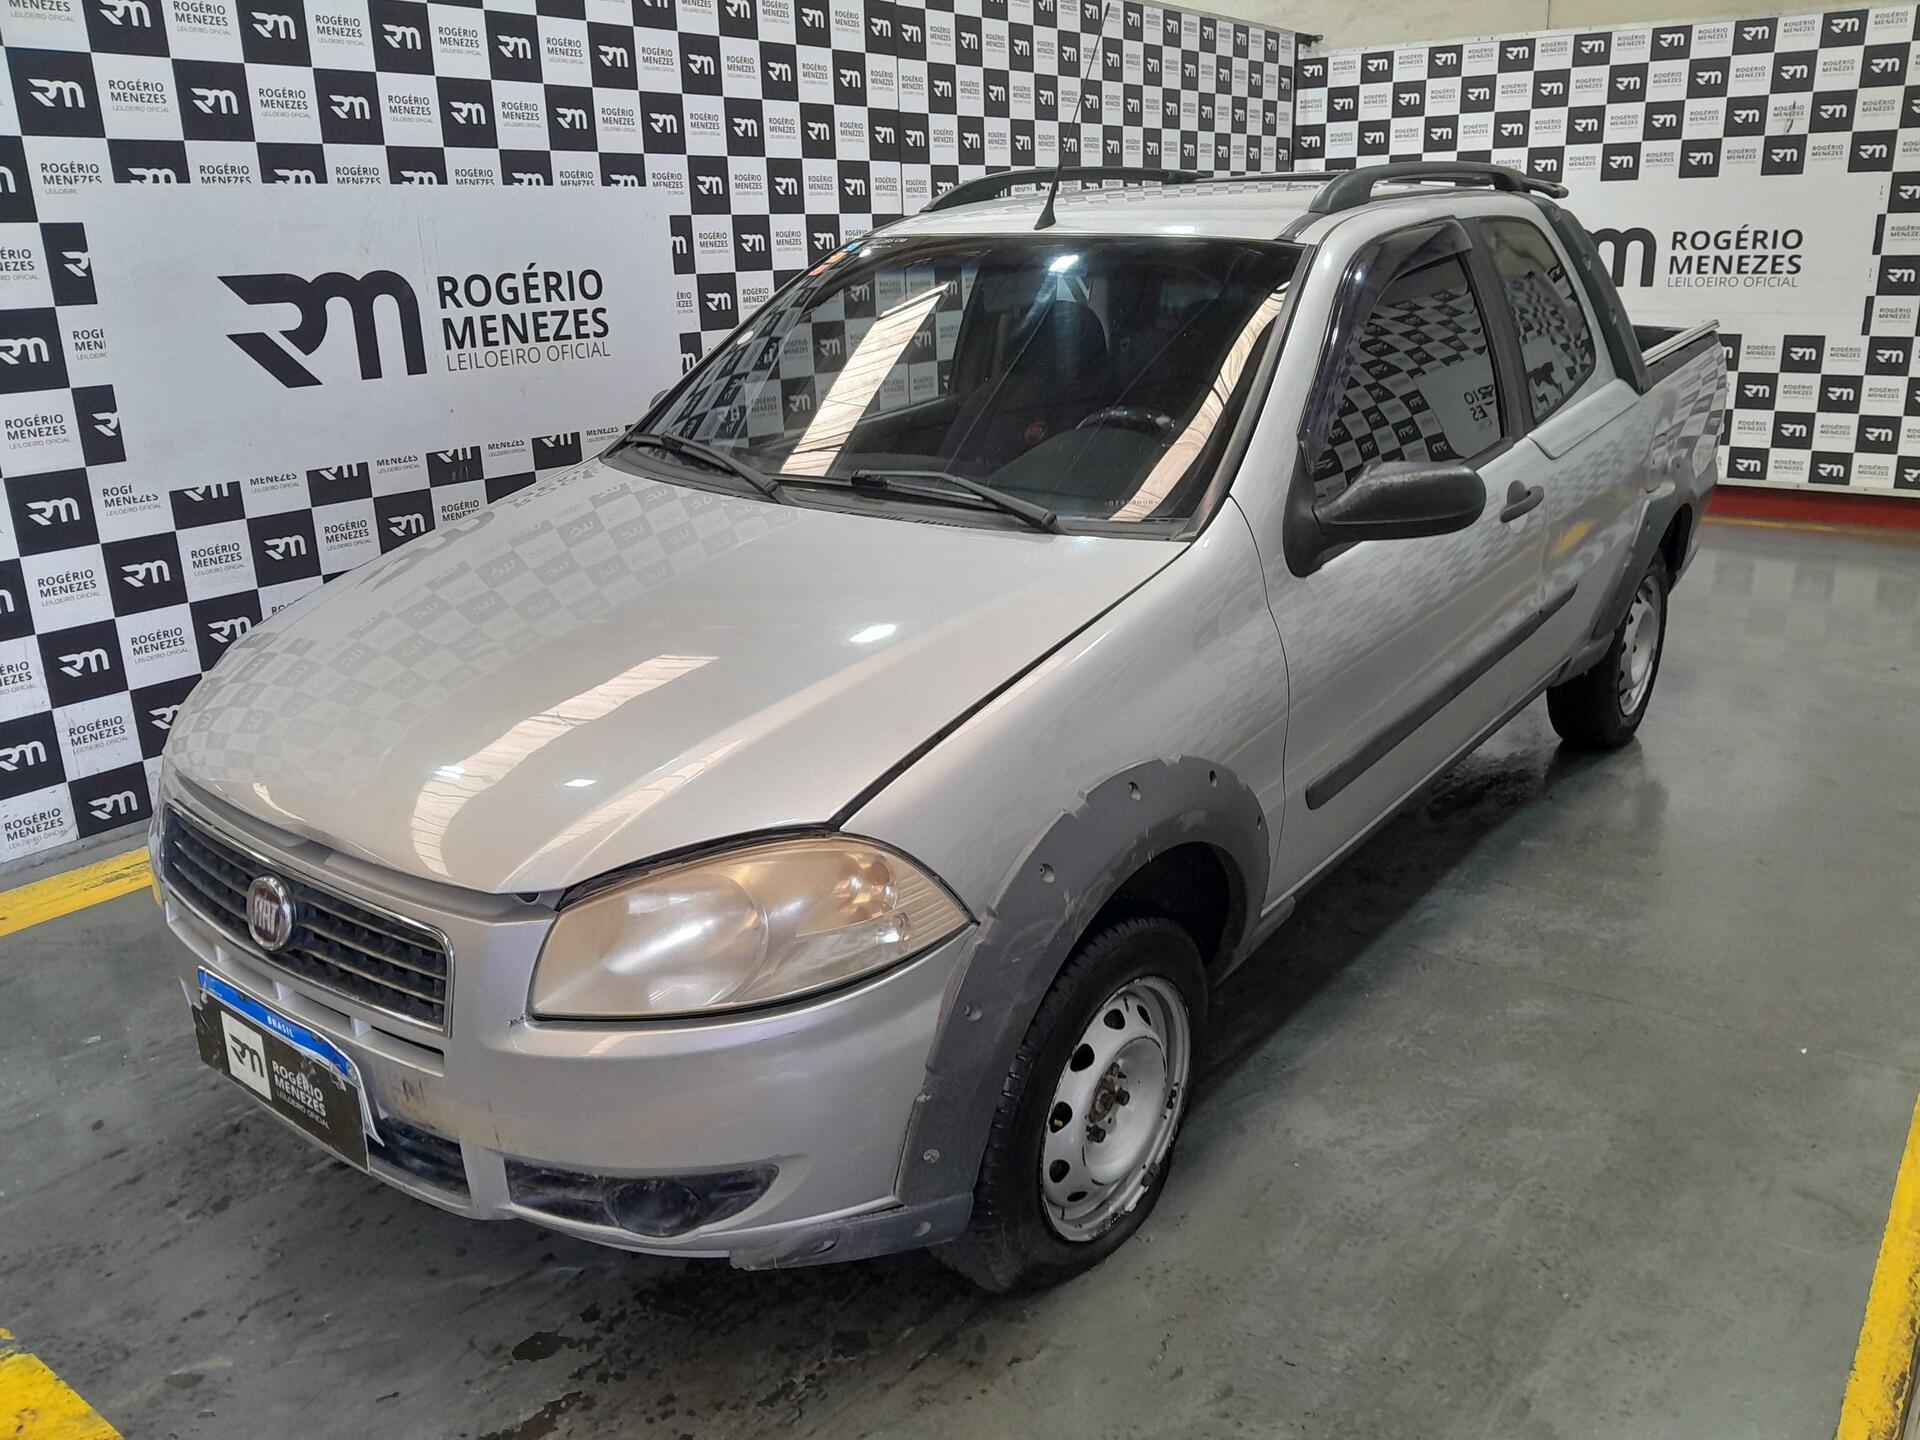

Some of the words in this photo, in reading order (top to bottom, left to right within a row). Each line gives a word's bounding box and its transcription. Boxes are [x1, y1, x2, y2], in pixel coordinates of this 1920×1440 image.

[9, 0, 71, 12] MENEZES
[173, 0, 226, 15] ROGÉRIO
[175, 12, 228, 26] MENEZES
[315, 14, 361, 27] ROGÉRIO
[316, 26, 363, 38] MENEZES
[438, 26, 477, 37] ROGÉRIO
[439, 36, 479, 47] MENEZES
[546, 37, 581, 47] ROGÉRIO
[547, 46, 582, 57] MENEZES
[641, 46, 672, 56] ROGÉRIO
[642, 55, 673, 65] MENEZES
[726, 55, 754, 64] ROGÉRIO
[727, 63, 754, 72] MENEZES
[802, 63, 827, 71] ROGÉRIO
[802, 71, 827, 79] MENEZES
[108, 79, 163, 92] ROGÉRIO
[110, 91, 166, 103] MENEZES
[258, 88, 305, 98] ROGÉRIO
[260, 99, 308, 109] MENEZES
[387, 95, 429, 105] ROGÉRIO
[501, 101, 537, 110] ROGÉRIO
[389, 105, 431, 114] MENEZES
[502, 111, 539, 120] MENEZES
[601, 107, 633, 116] ROGÉRIO
[602, 116, 634, 125] MENEZES
[689, 112, 718, 121] ROGÉRIO
[690, 121, 719, 129] MENEZES
[839, 121, 863, 129] ROGÉRIO
[40, 160, 99, 175] ROGÉRIO
[199, 163, 250, 175] ROGÉRIO
[335, 165, 380, 176] ROGÉRIO
[454, 168, 494, 180] ROGÉRIO
[559, 169, 594, 181] ROGÉRIO
[652, 171, 682, 182] ROGÉRIO
[775, 230, 802, 240] ROGÉRIO
[1671, 224, 1803, 250] ROGÉRIO
[776, 238, 802, 247] MENEZES
[1668, 254, 1802, 275] MENEZES
[436, 262, 603, 309] ROGÉRIO
[1667, 276, 1739, 288] LEILOEIRO
[1743, 276, 1799, 288] OFICIAL
[442, 307, 609, 351] MENEZES
[446, 347, 541, 371] LEILOEIRO
[548, 341, 611, 363] OFICIAL
[4, 414, 63, 428] ROGÉRIO
[6, 425, 66, 439] MENEZES
[440, 498, 480, 515] ROGÉRIO
[324, 519, 367, 534] ROGÉRIO
[325, 528, 369, 543] MENEZES
[191, 542, 239, 558] ROGÉRIO
[192, 551, 242, 568] MENEZES
[37, 569, 93, 587] ROGÉRIO
[39, 579, 96, 597] MENEZES
[131, 627, 182, 645] ROGÉRIO
[132, 636, 184, 655] MENEZES
[68, 715, 122, 736] ROGÉRIO
[70, 725, 125, 746] MENEZES
[4, 807, 61, 832] ROGÉRIO
[6, 817, 64, 841] MENEZES
[254, 893, 279, 934] FIAT
[267, 1015, 294, 1038] BRASIL
[272, 1060, 323, 1101] ROGÉRIO
[274, 1077, 326, 1117] MENEZES
